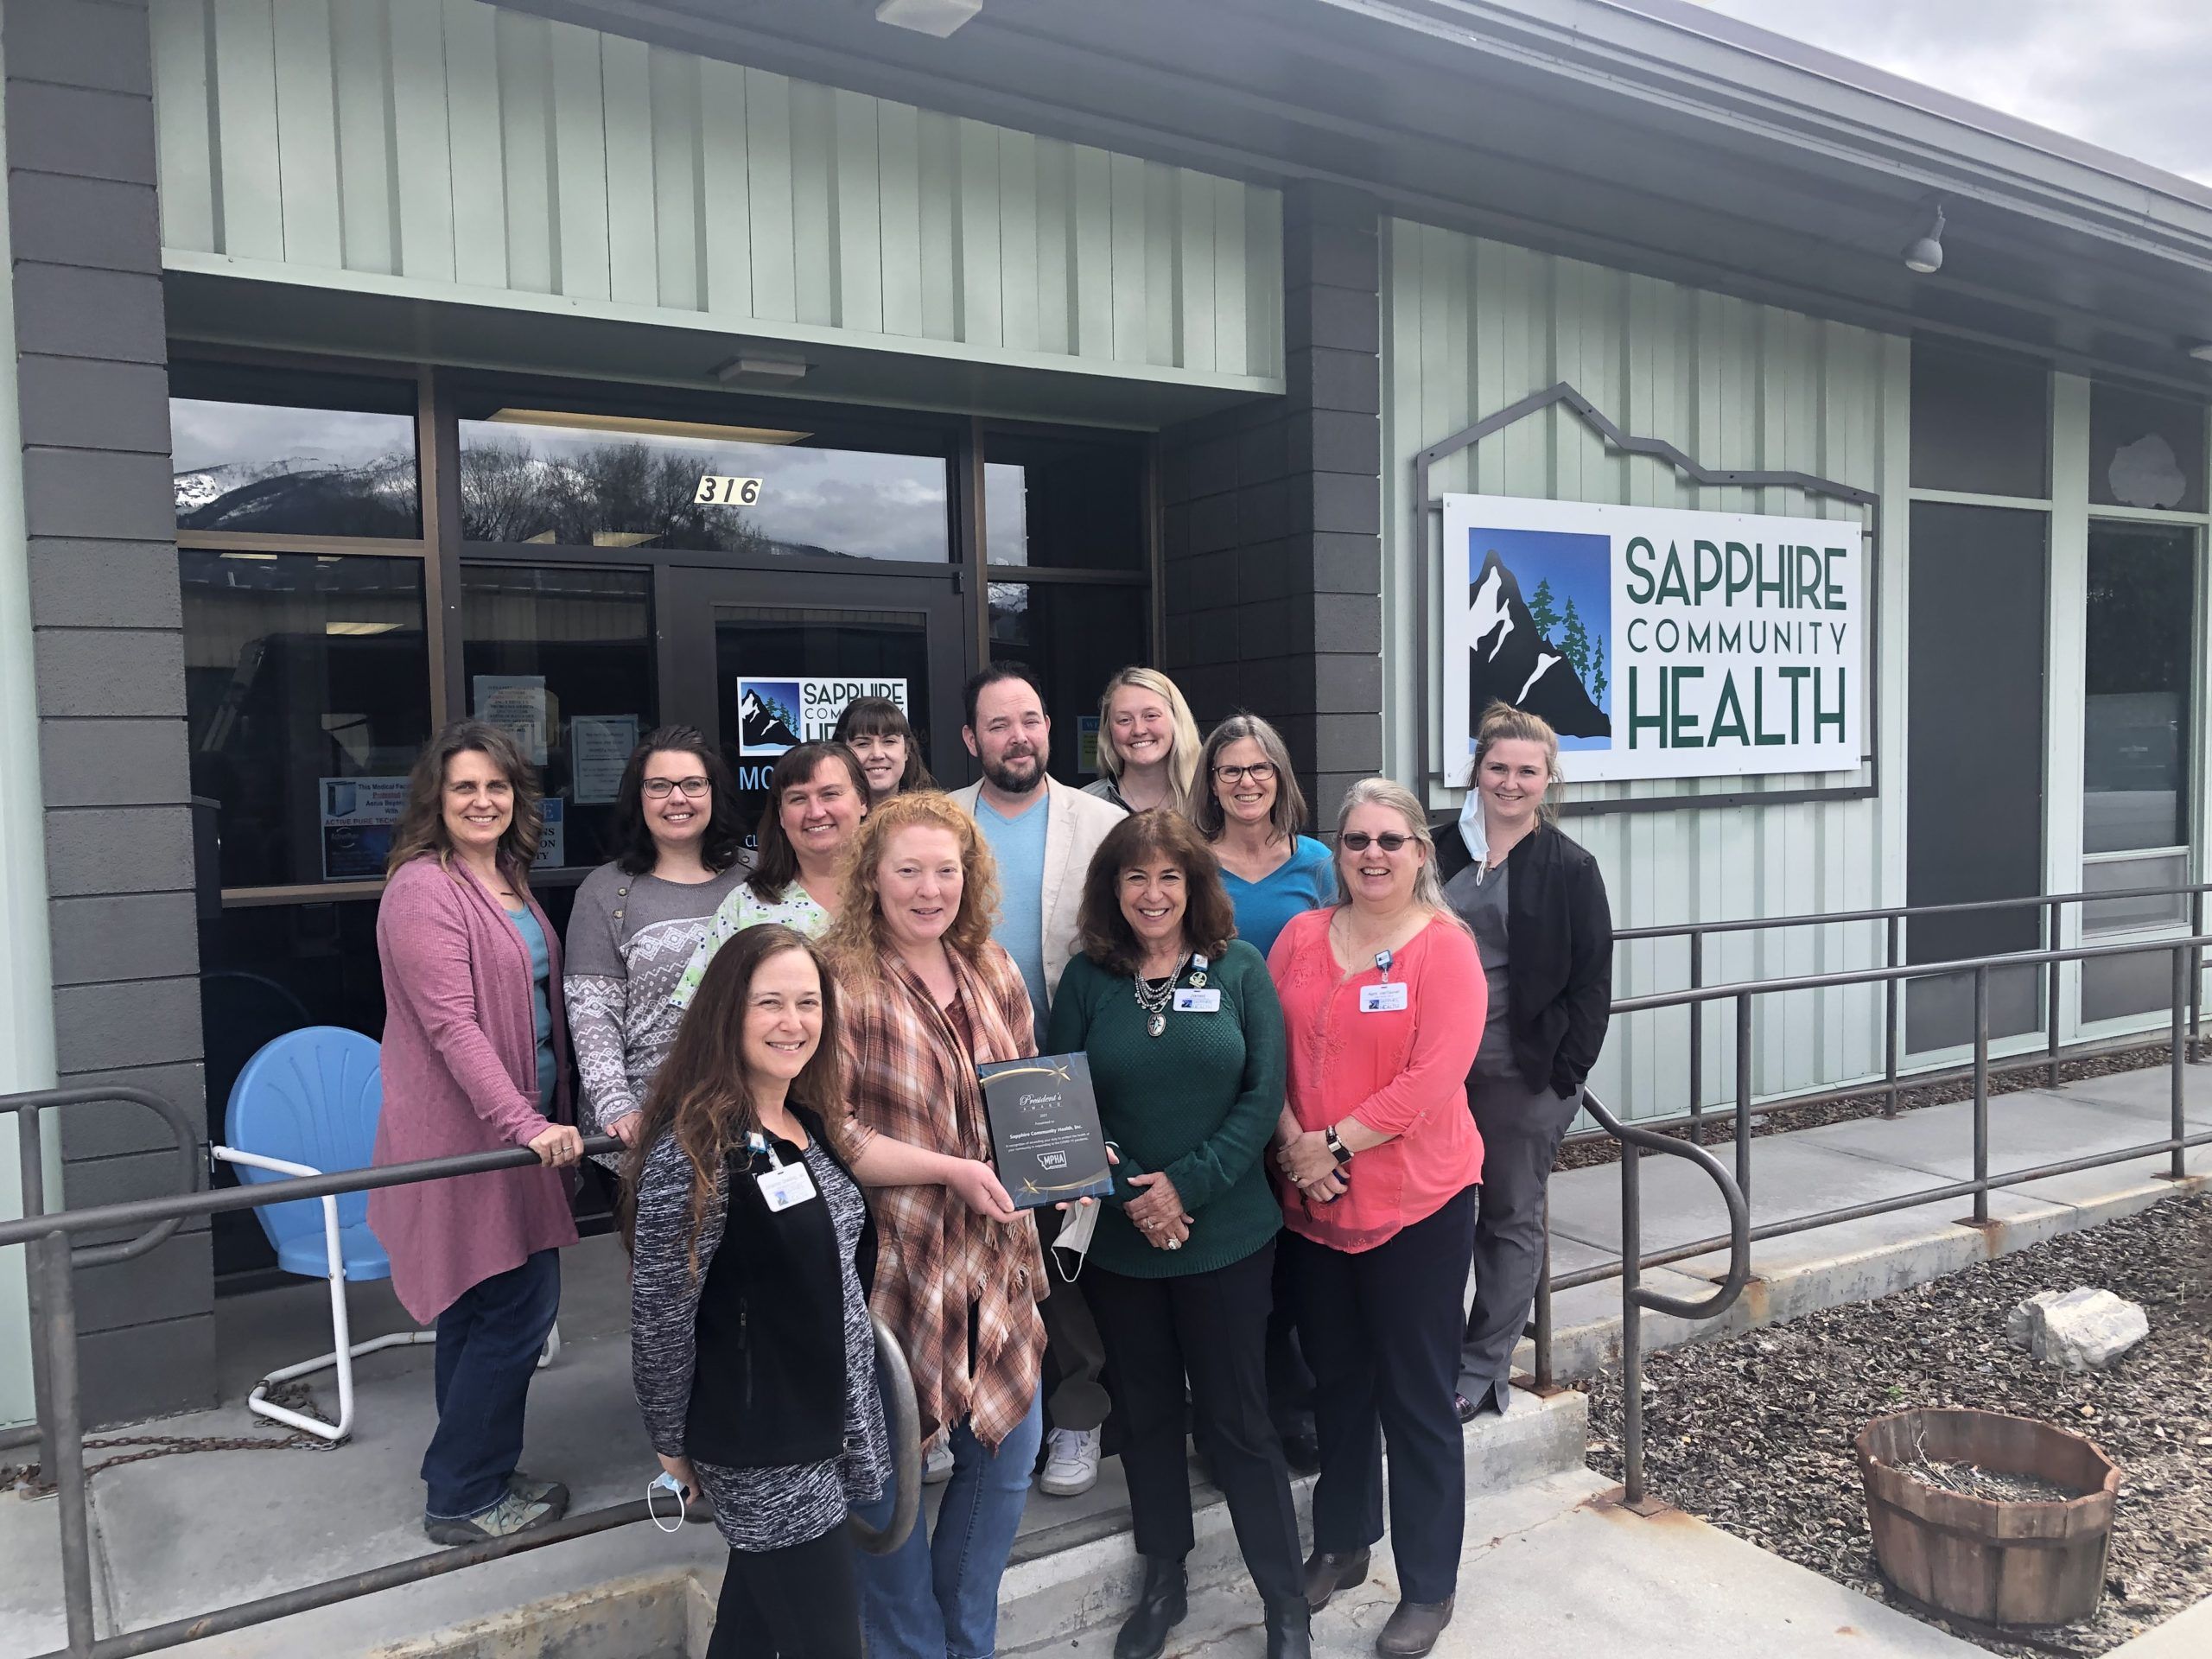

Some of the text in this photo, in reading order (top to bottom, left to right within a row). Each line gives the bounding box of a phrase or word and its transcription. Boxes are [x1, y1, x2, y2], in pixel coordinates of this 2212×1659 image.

[700, 477, 759, 504] 316
[1626, 536, 1847, 611] SAPPHIRE
[1627, 618, 1847, 654] COMMUNITY
[804, 683, 905, 705] SAPPHIRE
[1629, 666, 1846, 750] HEALTH
[1020, 1092, 1062, 1106] President's
[1009, 1131, 1030, 1140] Sapphire
[1031, 1128, 1057, 1136] Community
[1044, 1153, 1065, 1166] MPHA
